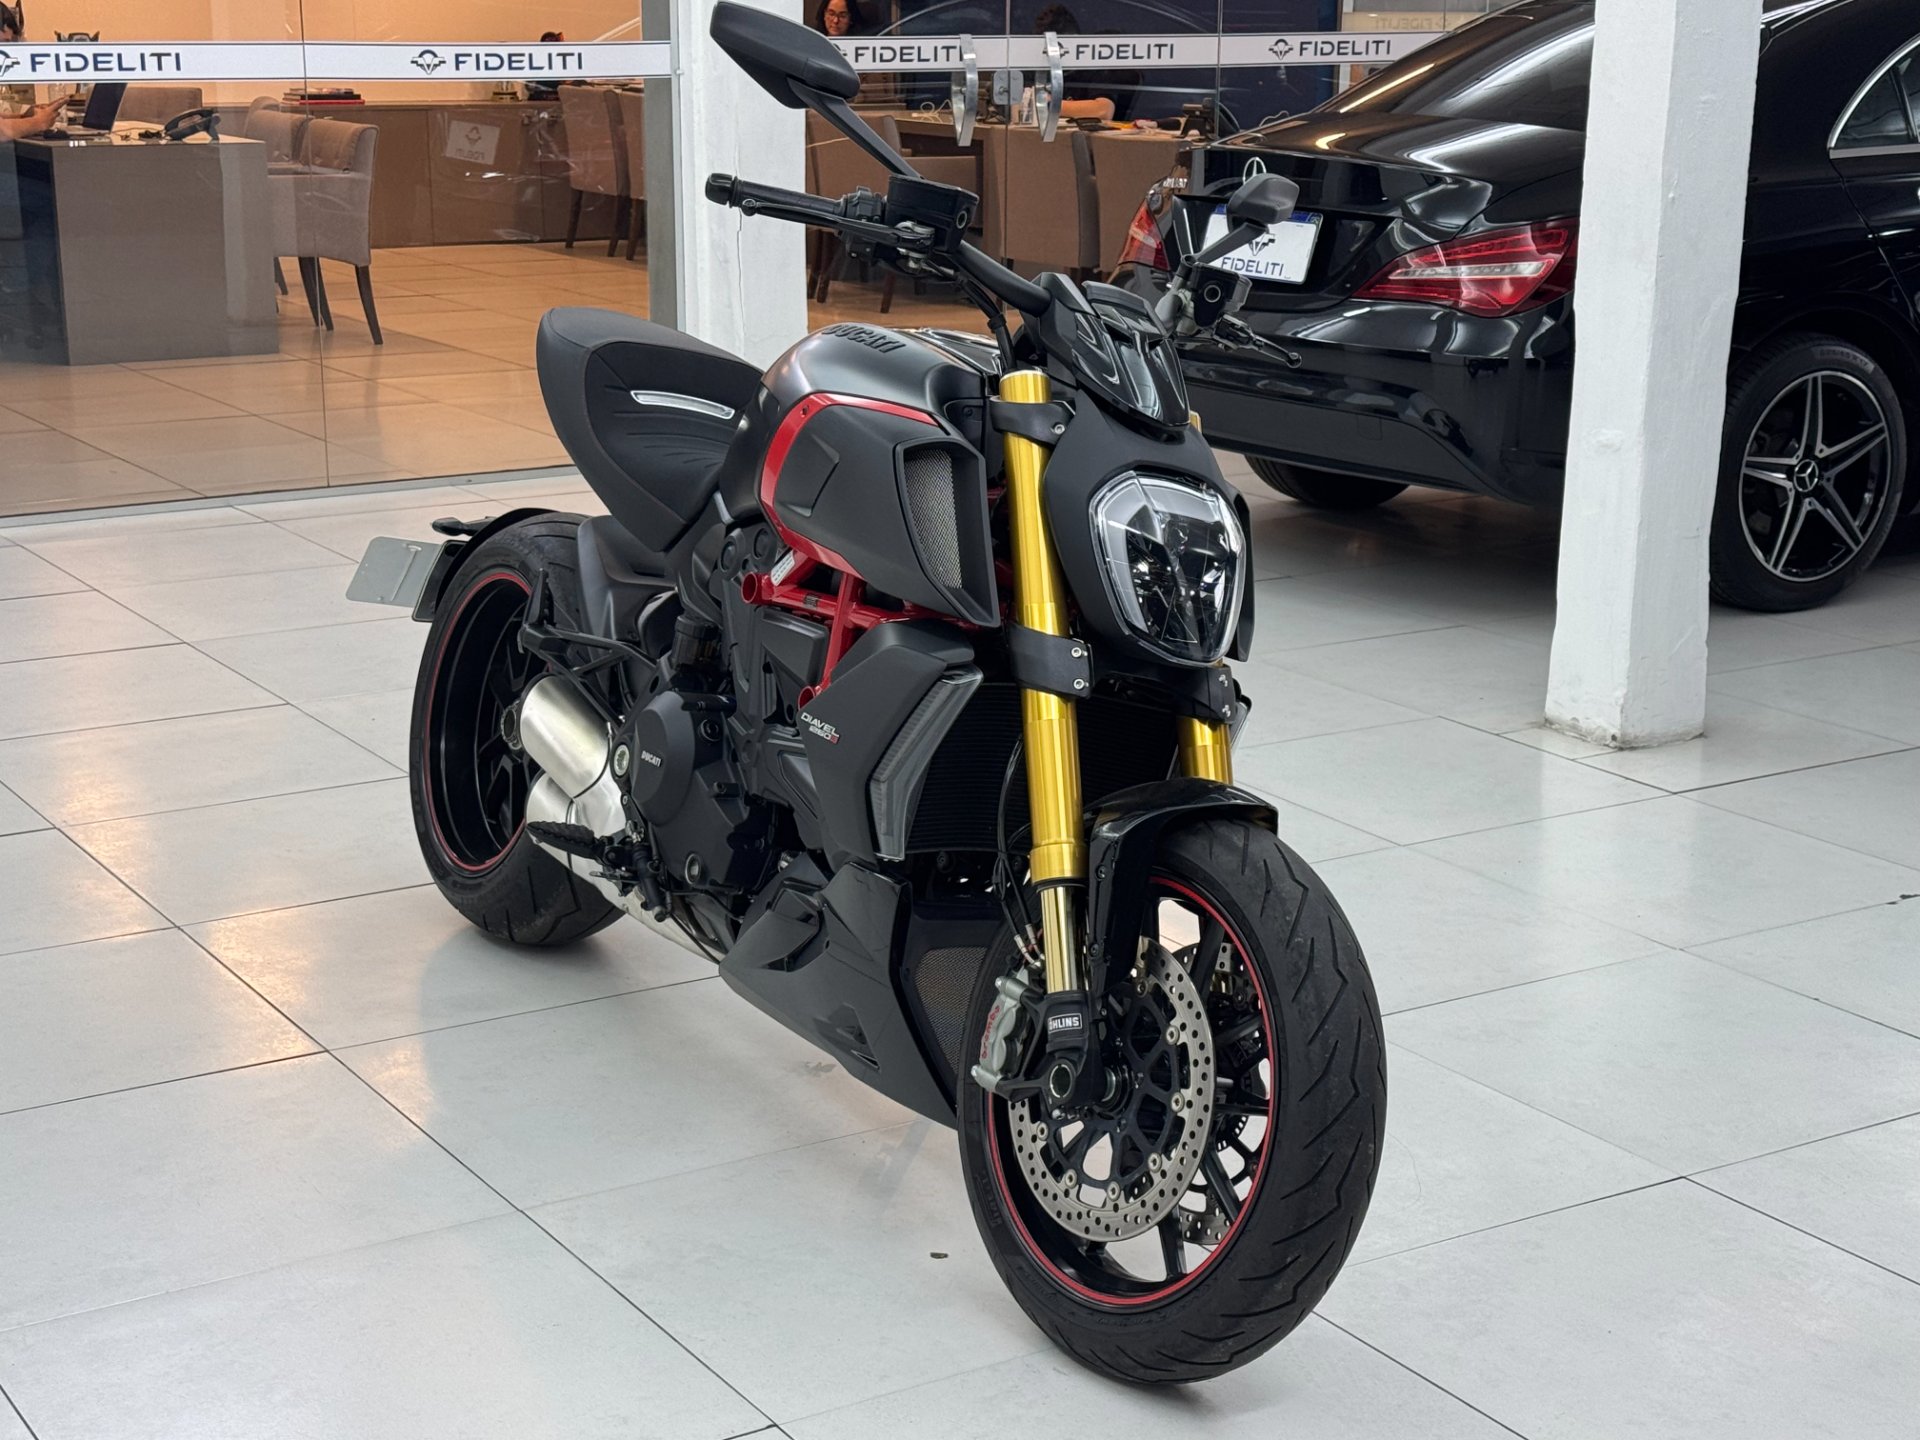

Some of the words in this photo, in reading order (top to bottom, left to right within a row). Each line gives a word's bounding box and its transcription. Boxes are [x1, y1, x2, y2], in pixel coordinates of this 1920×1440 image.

[1076, 43, 1174, 60] FIDELITI
[1299, 40, 1390, 56] FIDELITI
[30, 52, 182, 72] FIDELITI
[455, 52, 582, 71] FIDELITI
[1221, 256, 1284, 276] FIDELITI
[821, 324, 906, 353] DUCATI
[801, 712, 840, 738] DIAVEL
[641, 750, 661, 767] DUCATI
[981, 1005, 1000, 1059] brembo
